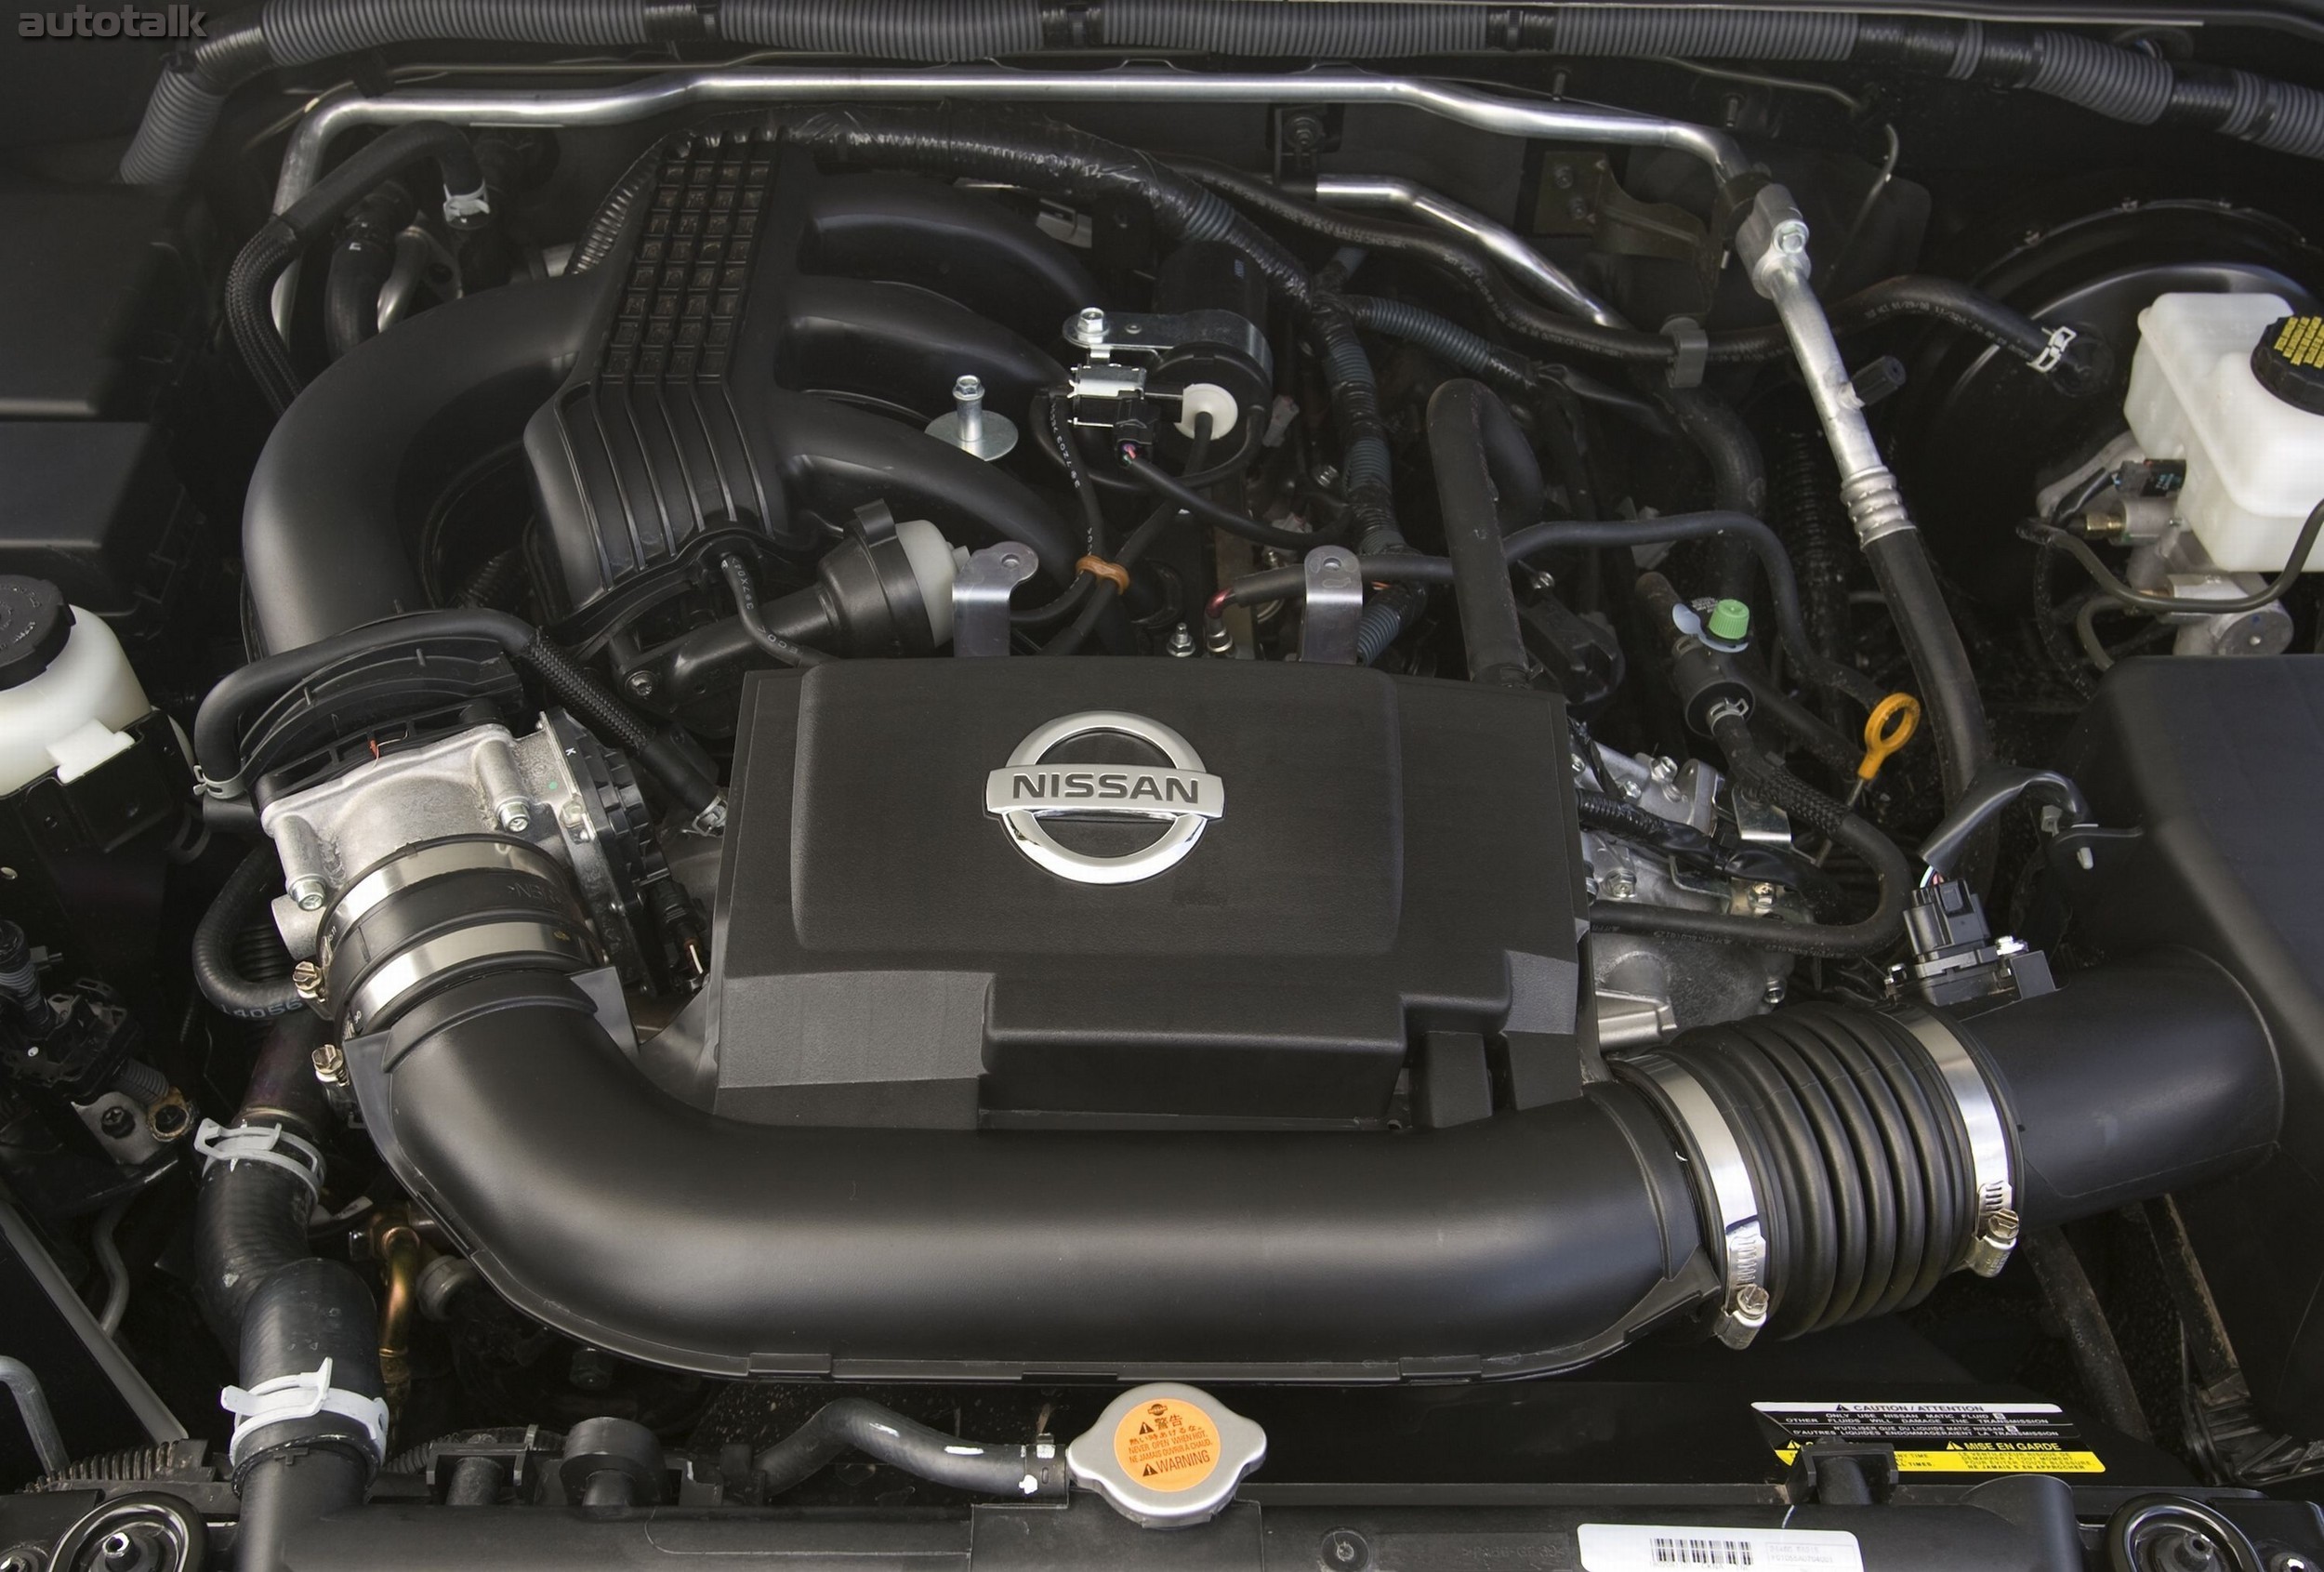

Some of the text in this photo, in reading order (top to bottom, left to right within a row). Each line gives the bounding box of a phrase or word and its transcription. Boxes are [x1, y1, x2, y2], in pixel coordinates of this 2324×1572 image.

[1012, 773, 1198, 803] NISSAN
[1155, 1414, 1182, 1430] 警告
[1129, 1444, 1150, 1454] NEVER
[1152, 1439, 1169, 1449] OPEN
[1171, 1433, 1192, 1445] WHEN
[2016, 1443, 2062, 1451] GARDE
[1155, 1449, 1210, 1473] WARNING
